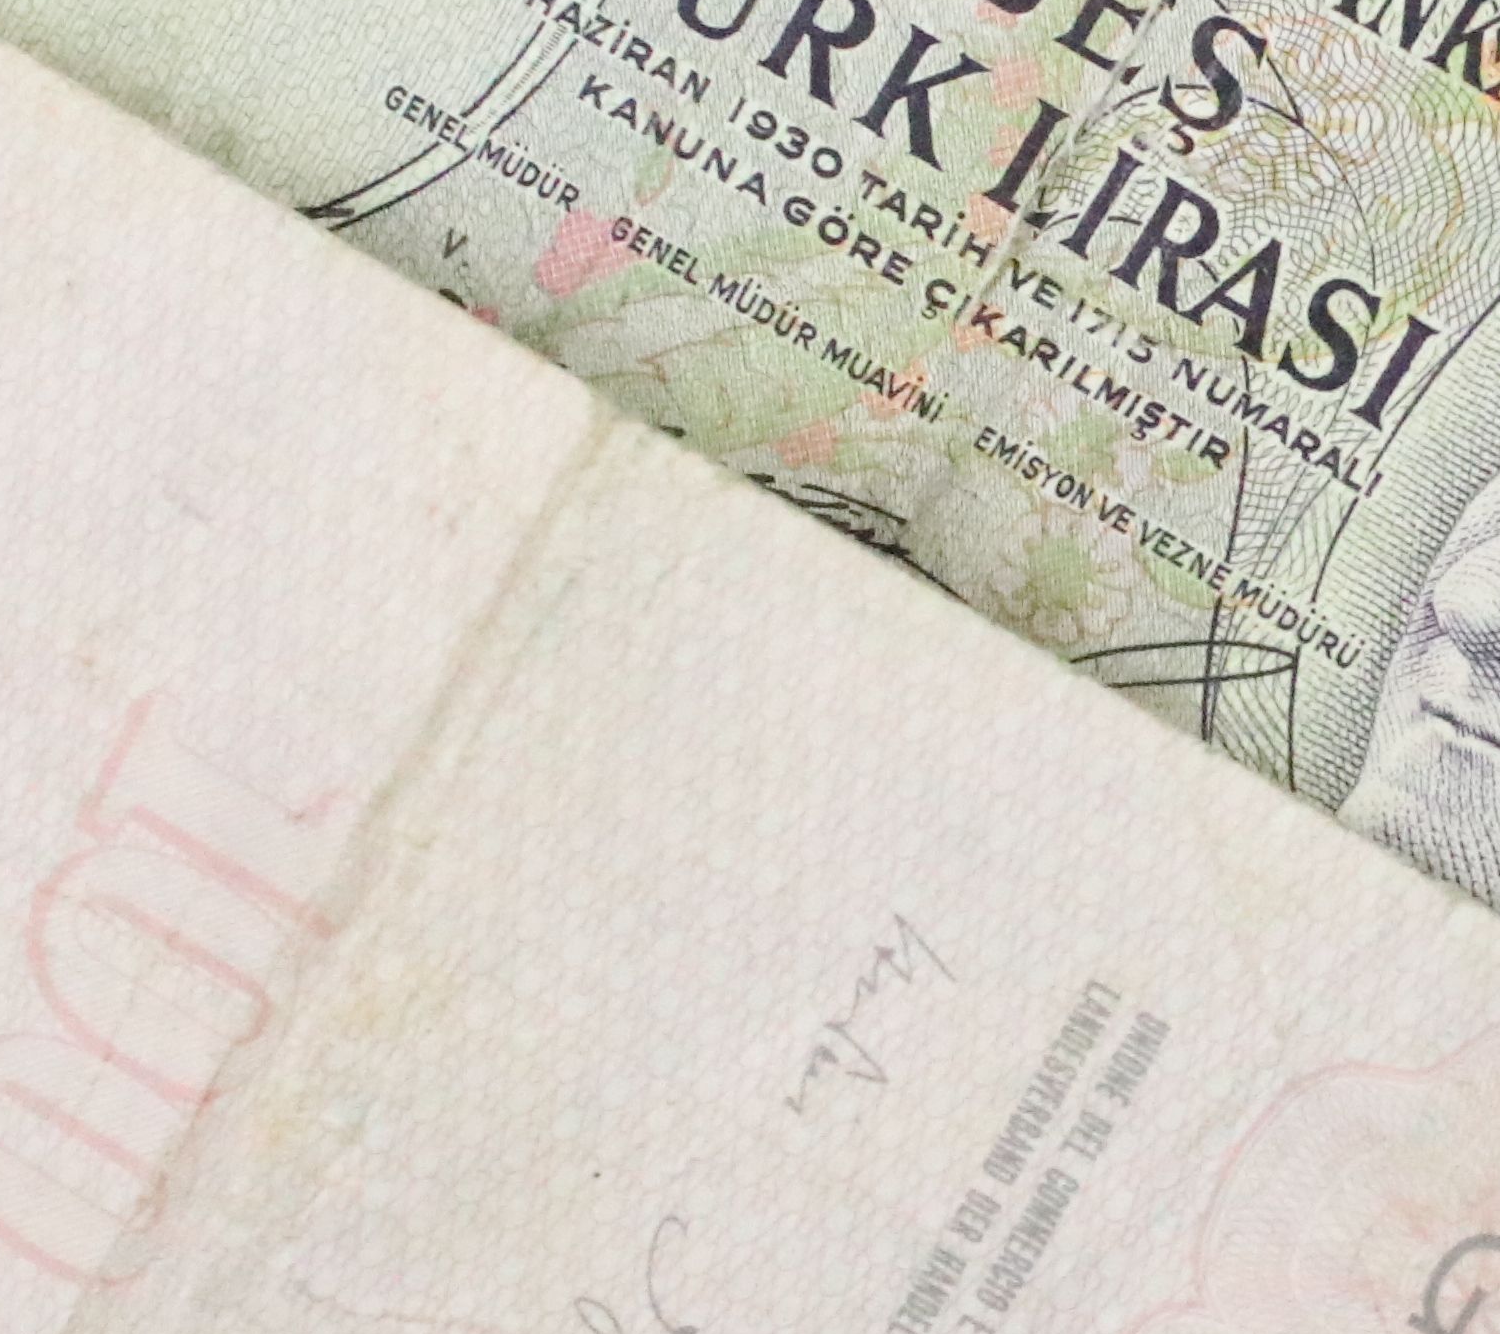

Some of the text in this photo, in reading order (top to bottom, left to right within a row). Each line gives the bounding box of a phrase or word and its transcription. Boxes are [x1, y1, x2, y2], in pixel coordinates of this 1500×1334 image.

[575, 73, 772, 218] KANUNA
[781, 189, 914, 289] GÖRE
[385, 84, 1366, 671] GENEL MÜDÜR GENEL MÜDÜR MUAVİNİ EMİSYON VE VEZNE MÜDÜRÜ
[725, 92, 846, 179] 1930
[858, 168, 995, 270] TARİH
[1005, 258, 1064, 310] VE
[1065, 295, 1155, 367] 1715
[1169, 356, 1384, 502] NUMARALI
[978, 977, 1123, 1189] LANDESVERBAND
[1058, 1106, 1116, 1168] DEL
[1092, 1007, 1174, 1110] UNIONE
[945, 1185, 1003, 1247] DER
[973, 1164, 1083, 1317] COMMERCIO
